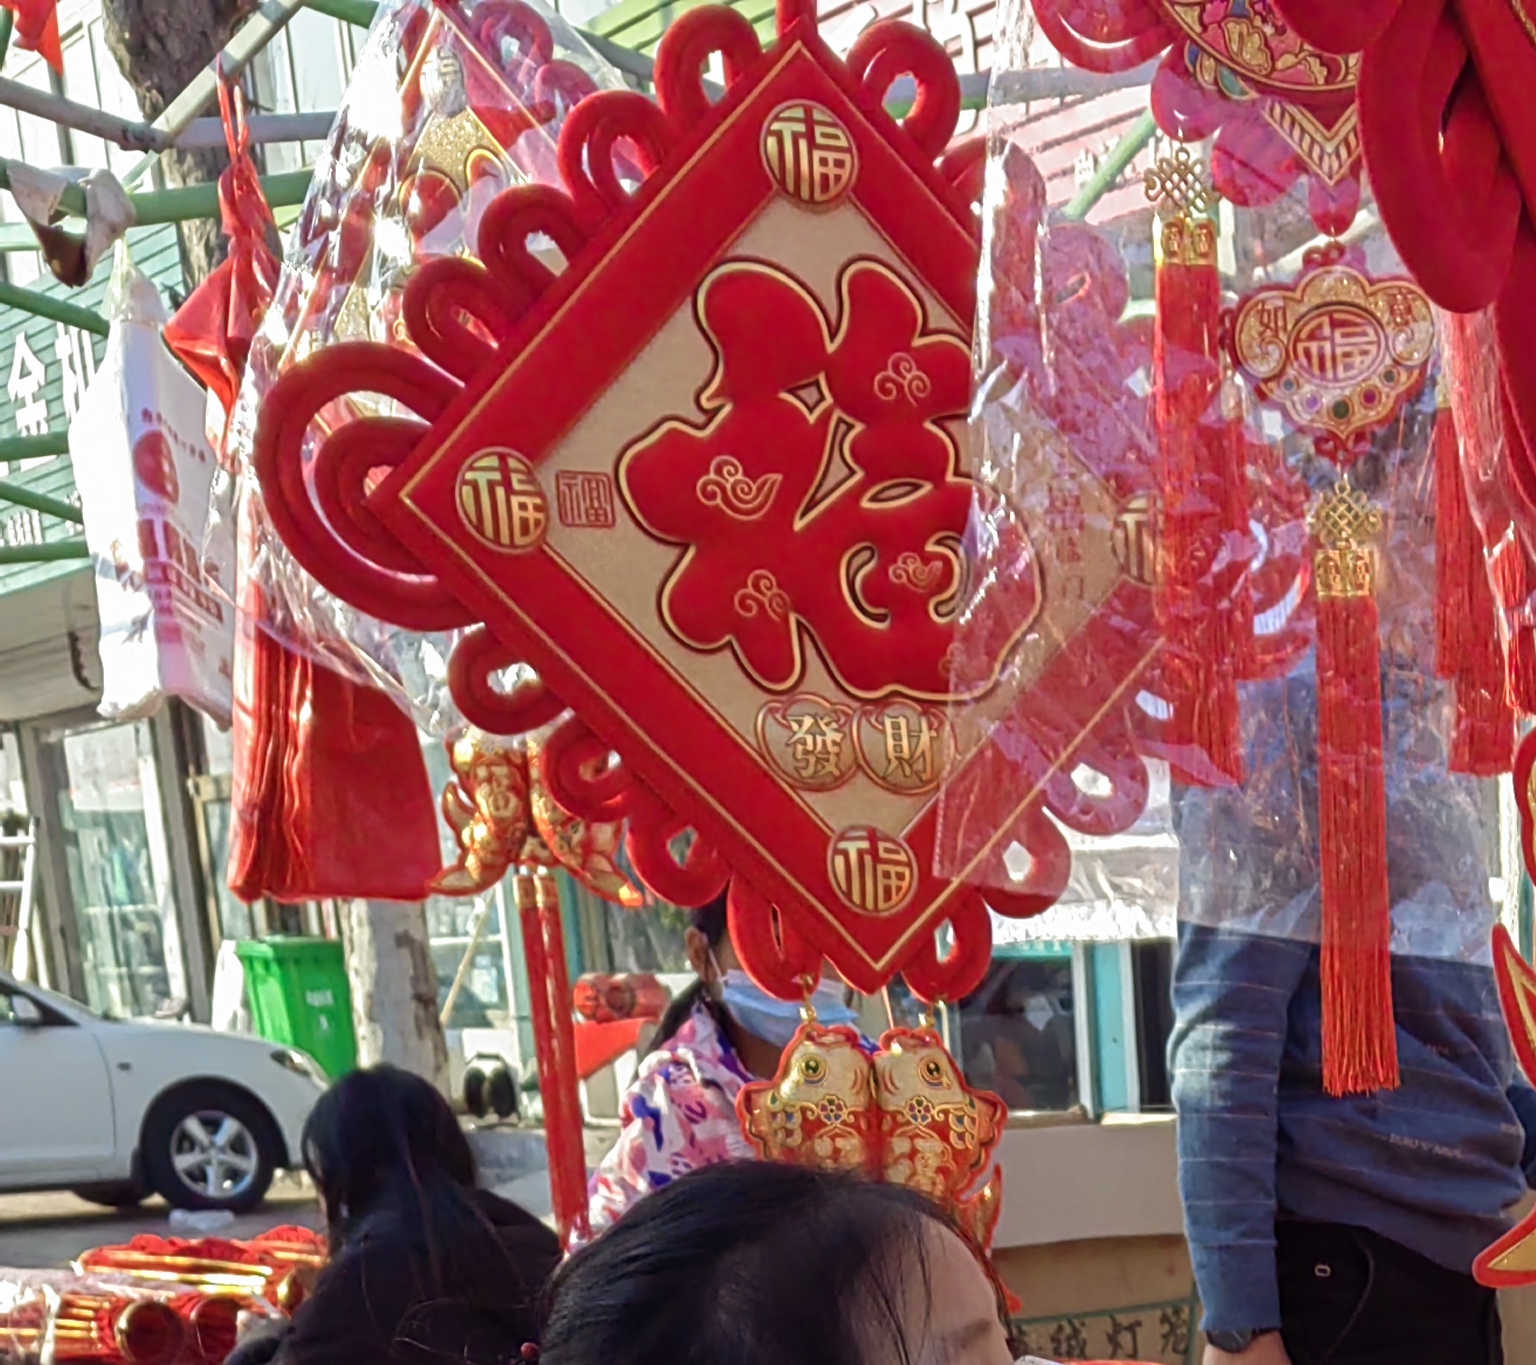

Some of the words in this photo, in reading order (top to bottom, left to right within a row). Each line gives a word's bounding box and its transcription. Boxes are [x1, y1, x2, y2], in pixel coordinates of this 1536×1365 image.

[764, 103, 857, 202] 福
[1297, 313, 1380, 385] 福
[459, 453, 547, 549] 福
[786, 712, 938, 781] 發財
[831, 828, 917, 914] 福
